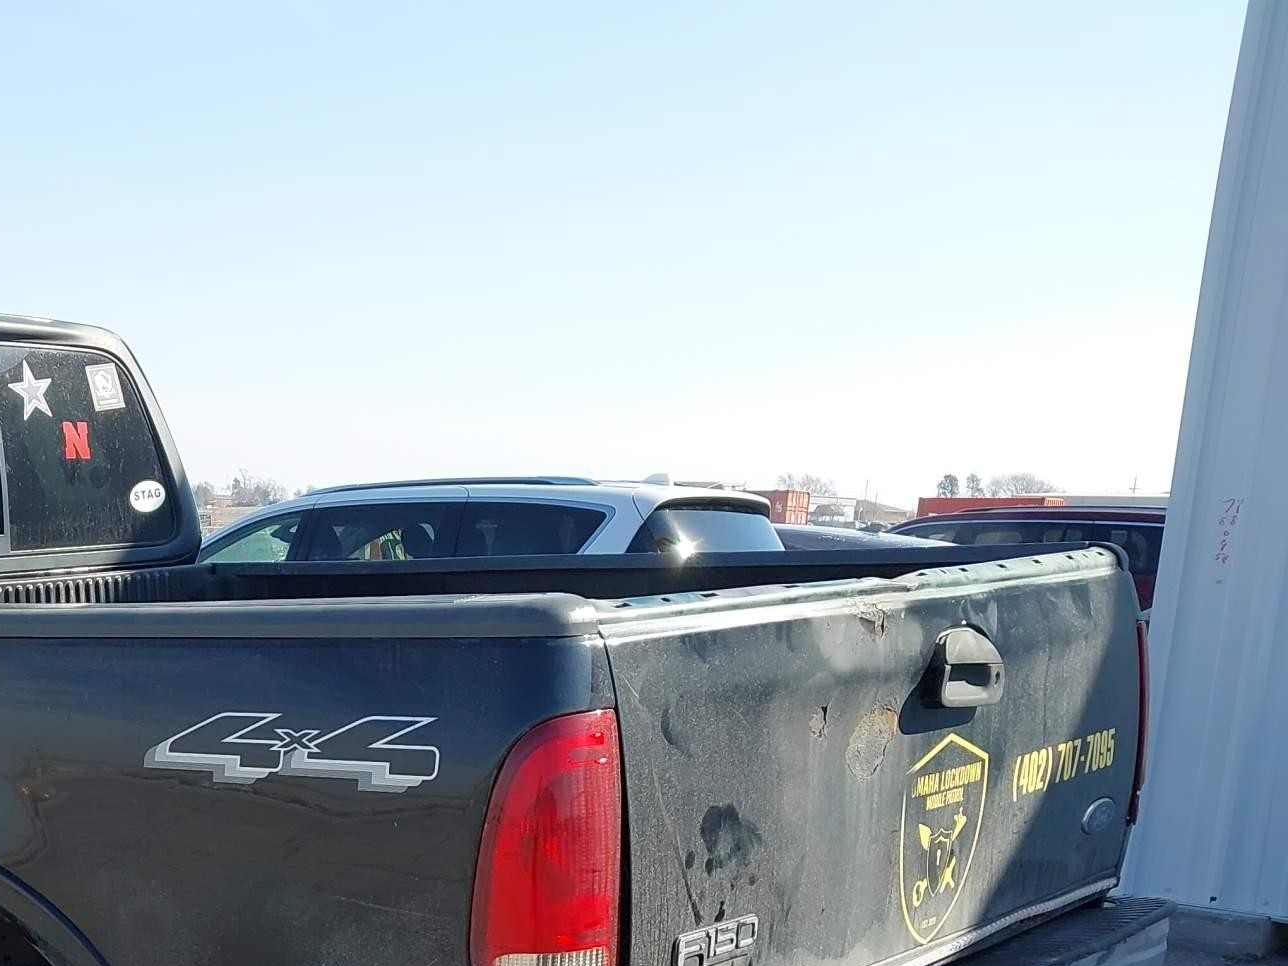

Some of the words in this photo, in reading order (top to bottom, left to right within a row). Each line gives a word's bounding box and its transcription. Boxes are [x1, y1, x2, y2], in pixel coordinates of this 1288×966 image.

[62, 421, 91, 460] N
[133, 487, 162, 501] STAG
[940, 761, 982, 792] LOCKDOWN
[1012, 746, 1053, 803] (402)
[1055, 727, 1116, 784] 707-7095
